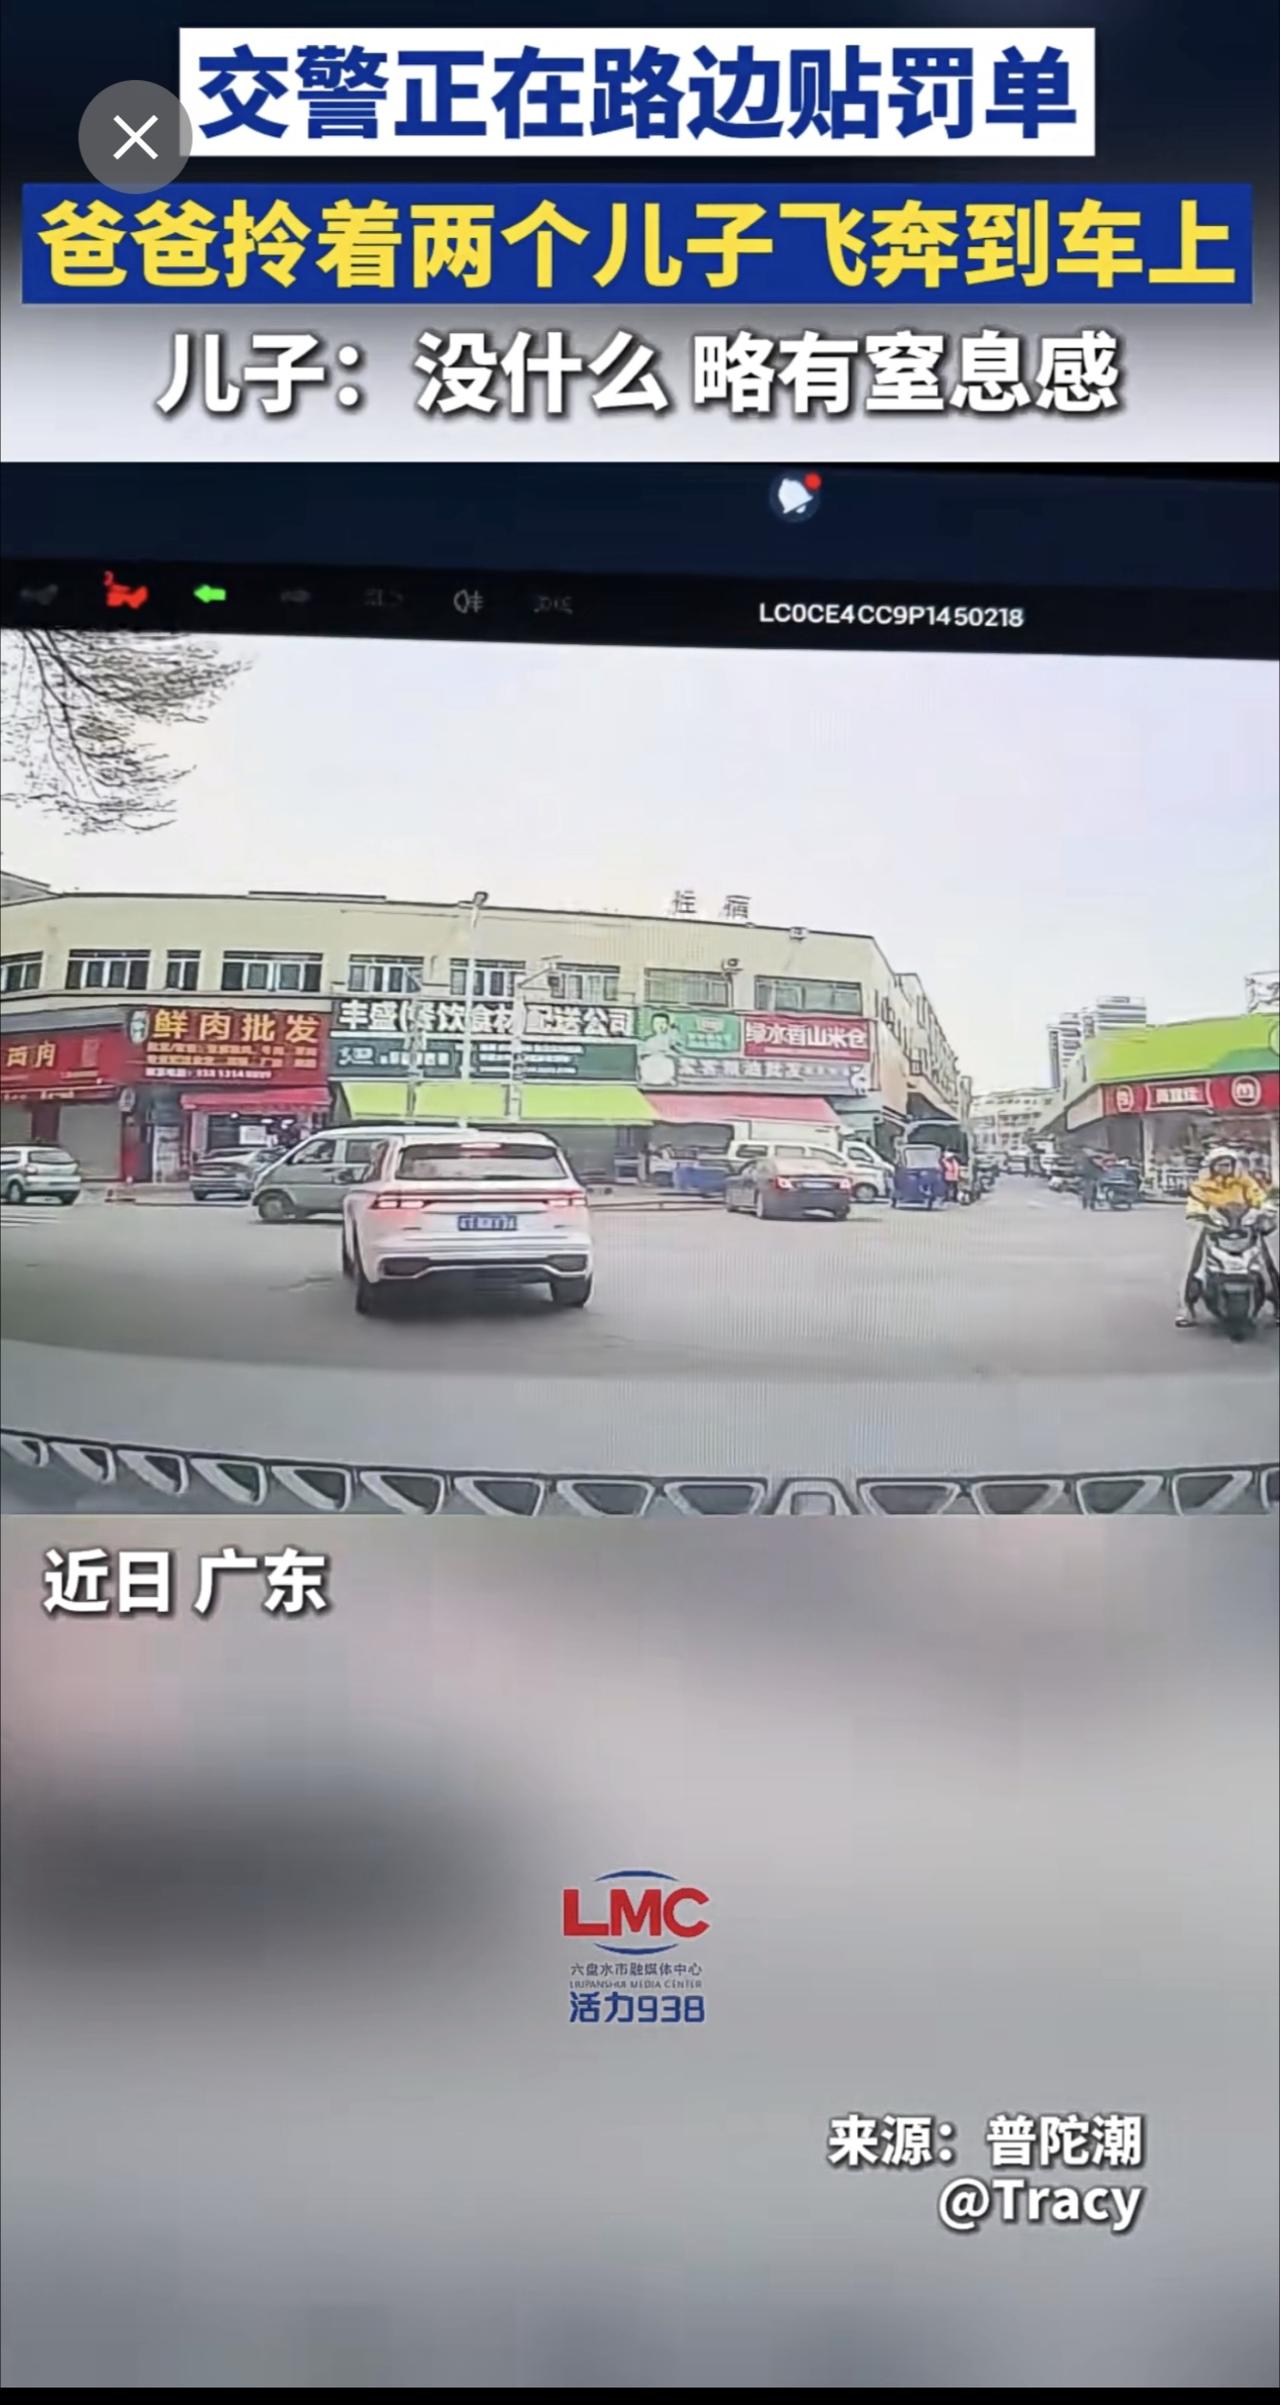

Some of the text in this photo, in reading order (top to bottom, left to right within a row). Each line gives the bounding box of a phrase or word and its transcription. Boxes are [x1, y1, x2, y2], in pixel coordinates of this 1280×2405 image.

[758, 602, 1025, 628] LC0CE4CC9P1450218
[152, 1008, 319, 1044] 鲜肉批发
